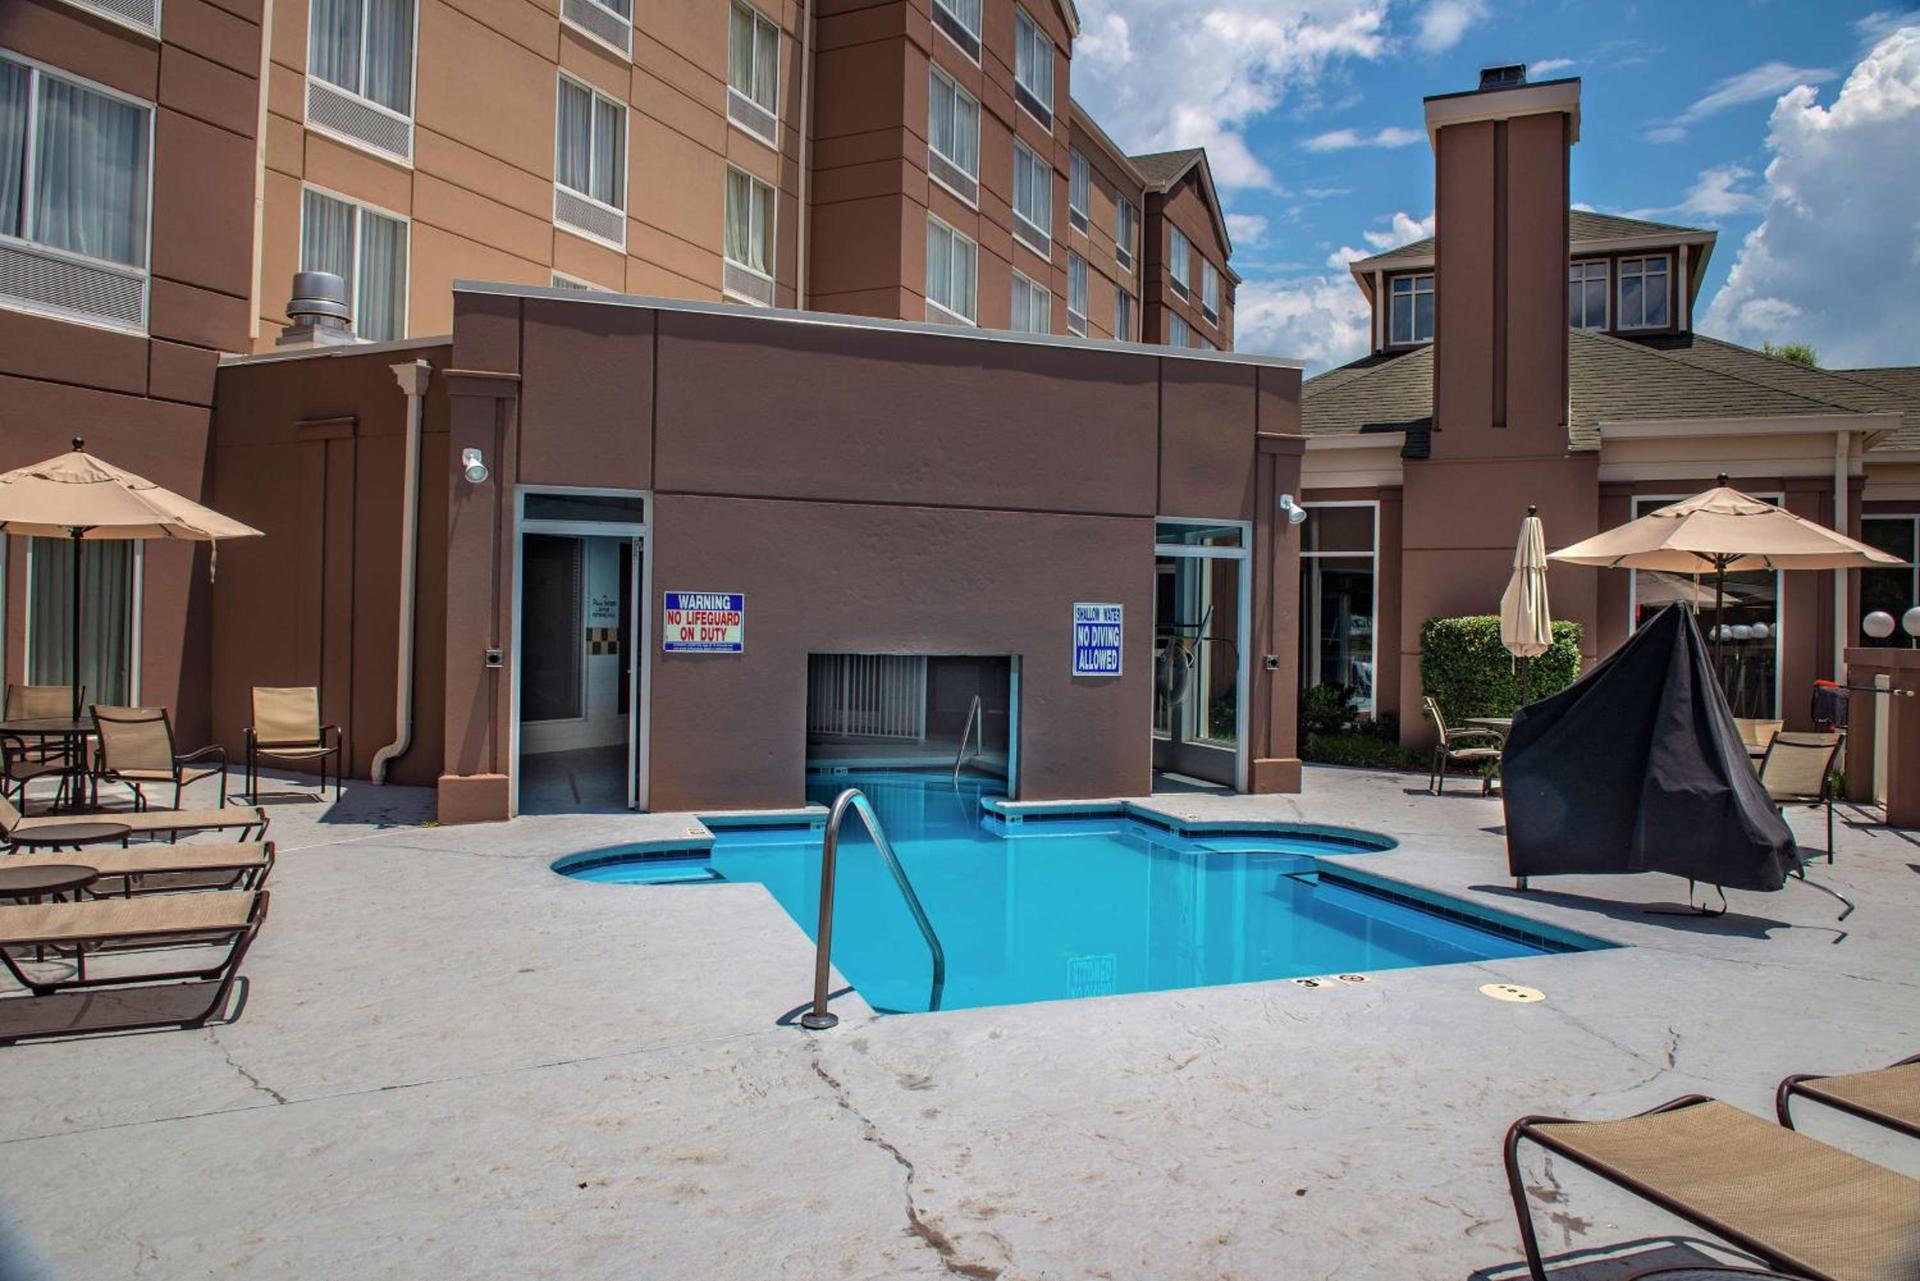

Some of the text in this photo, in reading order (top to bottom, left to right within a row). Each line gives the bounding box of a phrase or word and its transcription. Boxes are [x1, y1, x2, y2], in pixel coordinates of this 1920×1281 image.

[678, 594, 731, 610] WARNING
[667, 611, 740, 626] NO LIFEGUARD
[1077, 607, 1120, 622] SHALLOW WATER
[680, 627, 727, 641] ON DUTY
[1078, 626, 1119, 647] NO DIVING
[1079, 649, 1117, 670] ALLOWED
